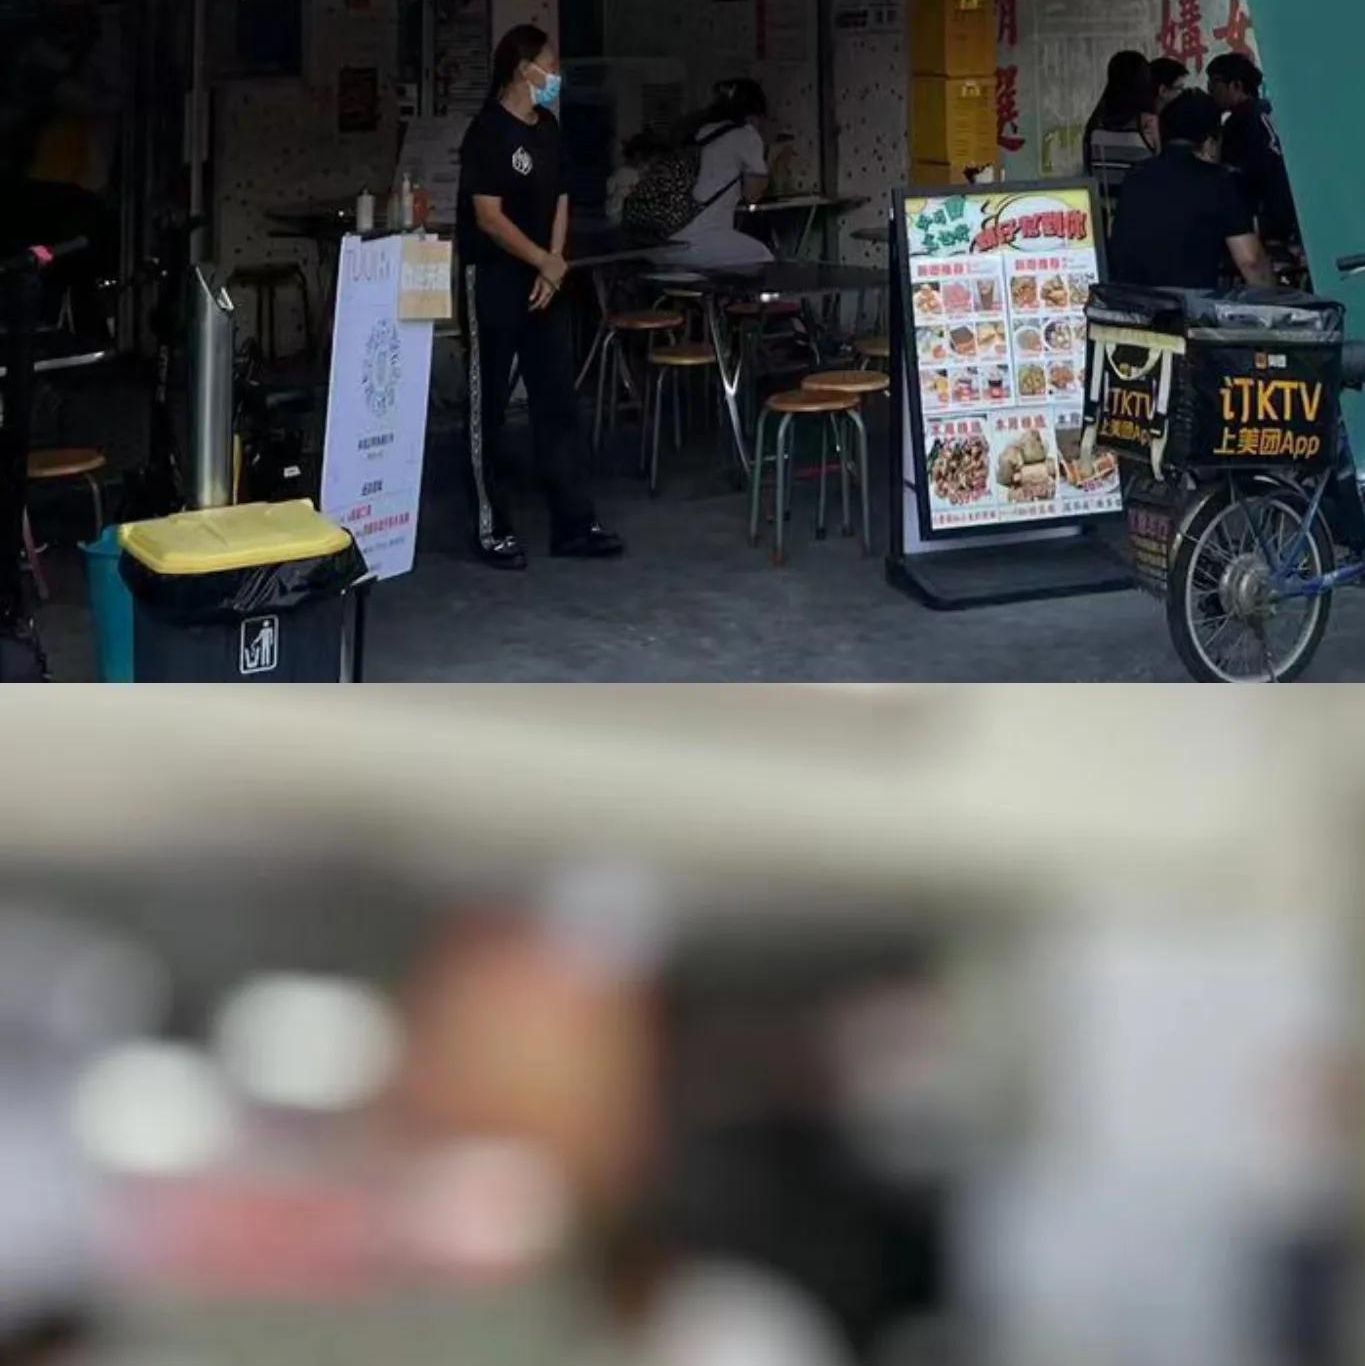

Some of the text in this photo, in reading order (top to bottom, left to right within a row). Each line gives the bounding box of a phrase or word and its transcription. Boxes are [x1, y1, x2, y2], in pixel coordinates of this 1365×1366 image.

[1218, 376, 1323, 424] 订KTV
[1213, 429, 1320, 459] 上美团App
